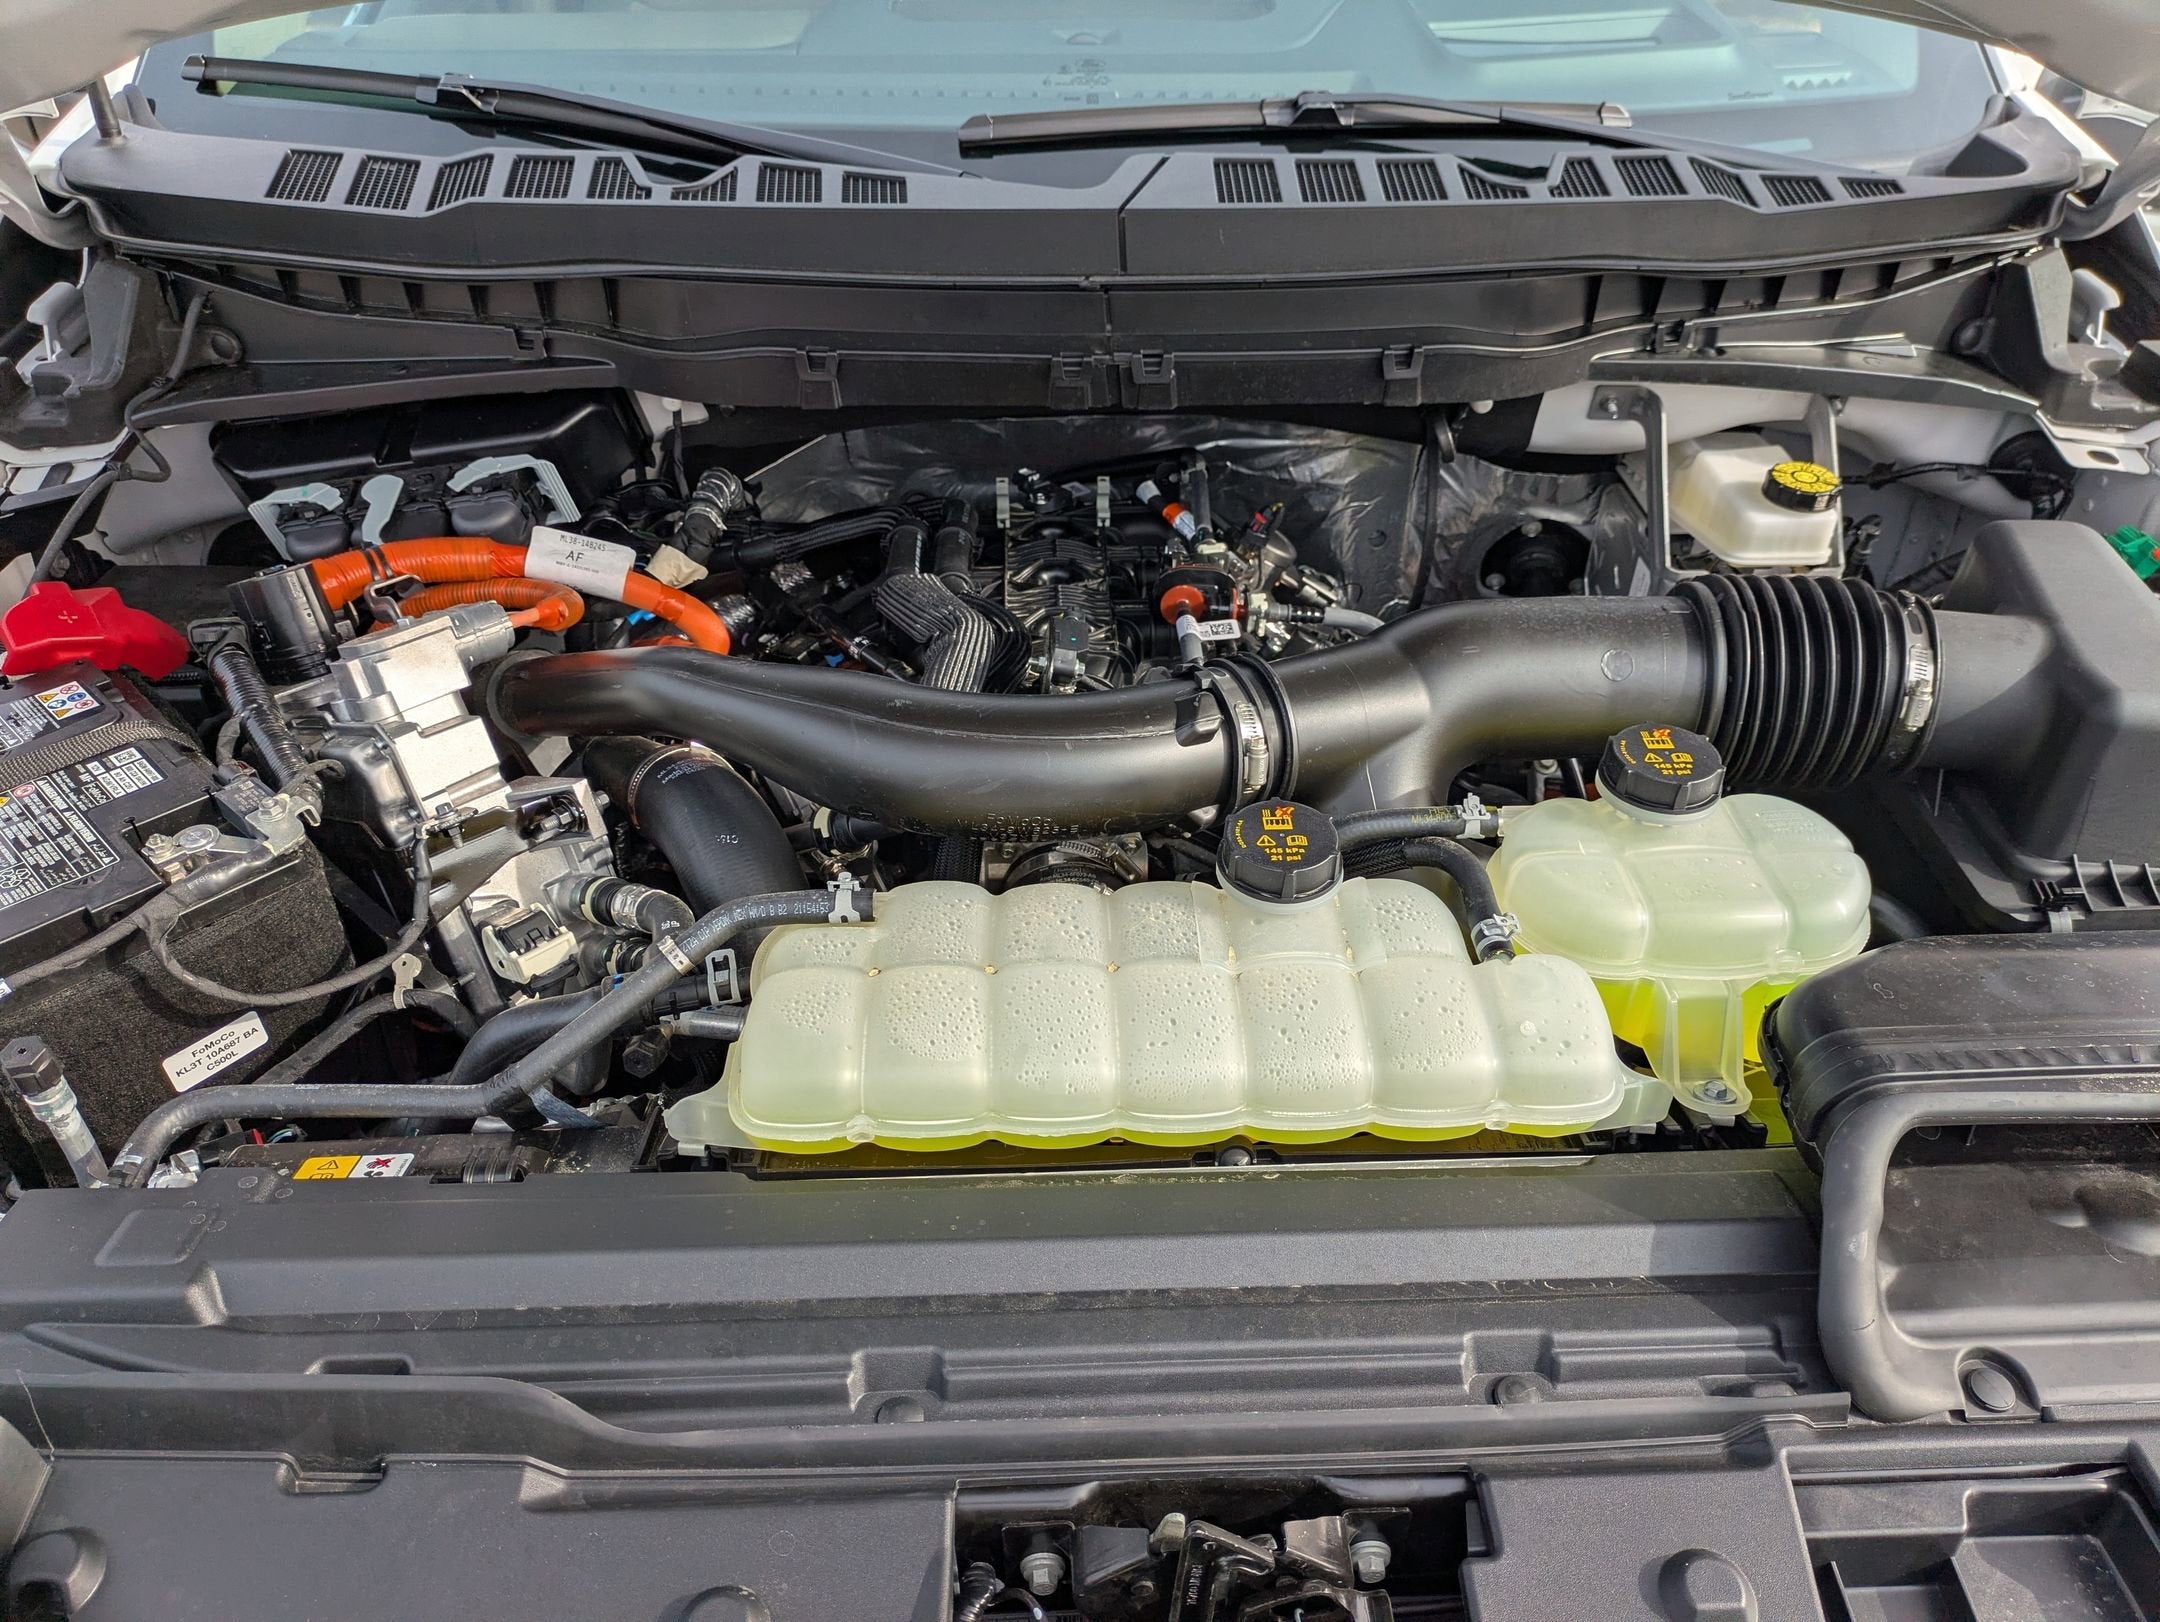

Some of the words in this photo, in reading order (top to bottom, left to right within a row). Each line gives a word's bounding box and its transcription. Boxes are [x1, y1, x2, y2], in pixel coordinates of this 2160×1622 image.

[565, 550, 584, 562] AF
[175, 1058, 202, 1078] KL3T
[206, 1036, 241, 1060] 10A687
[243, 1027, 259, 1039] BA
[191, 1030, 235, 1058] FoMoCo
[206, 1050, 238, 1071] C500L
